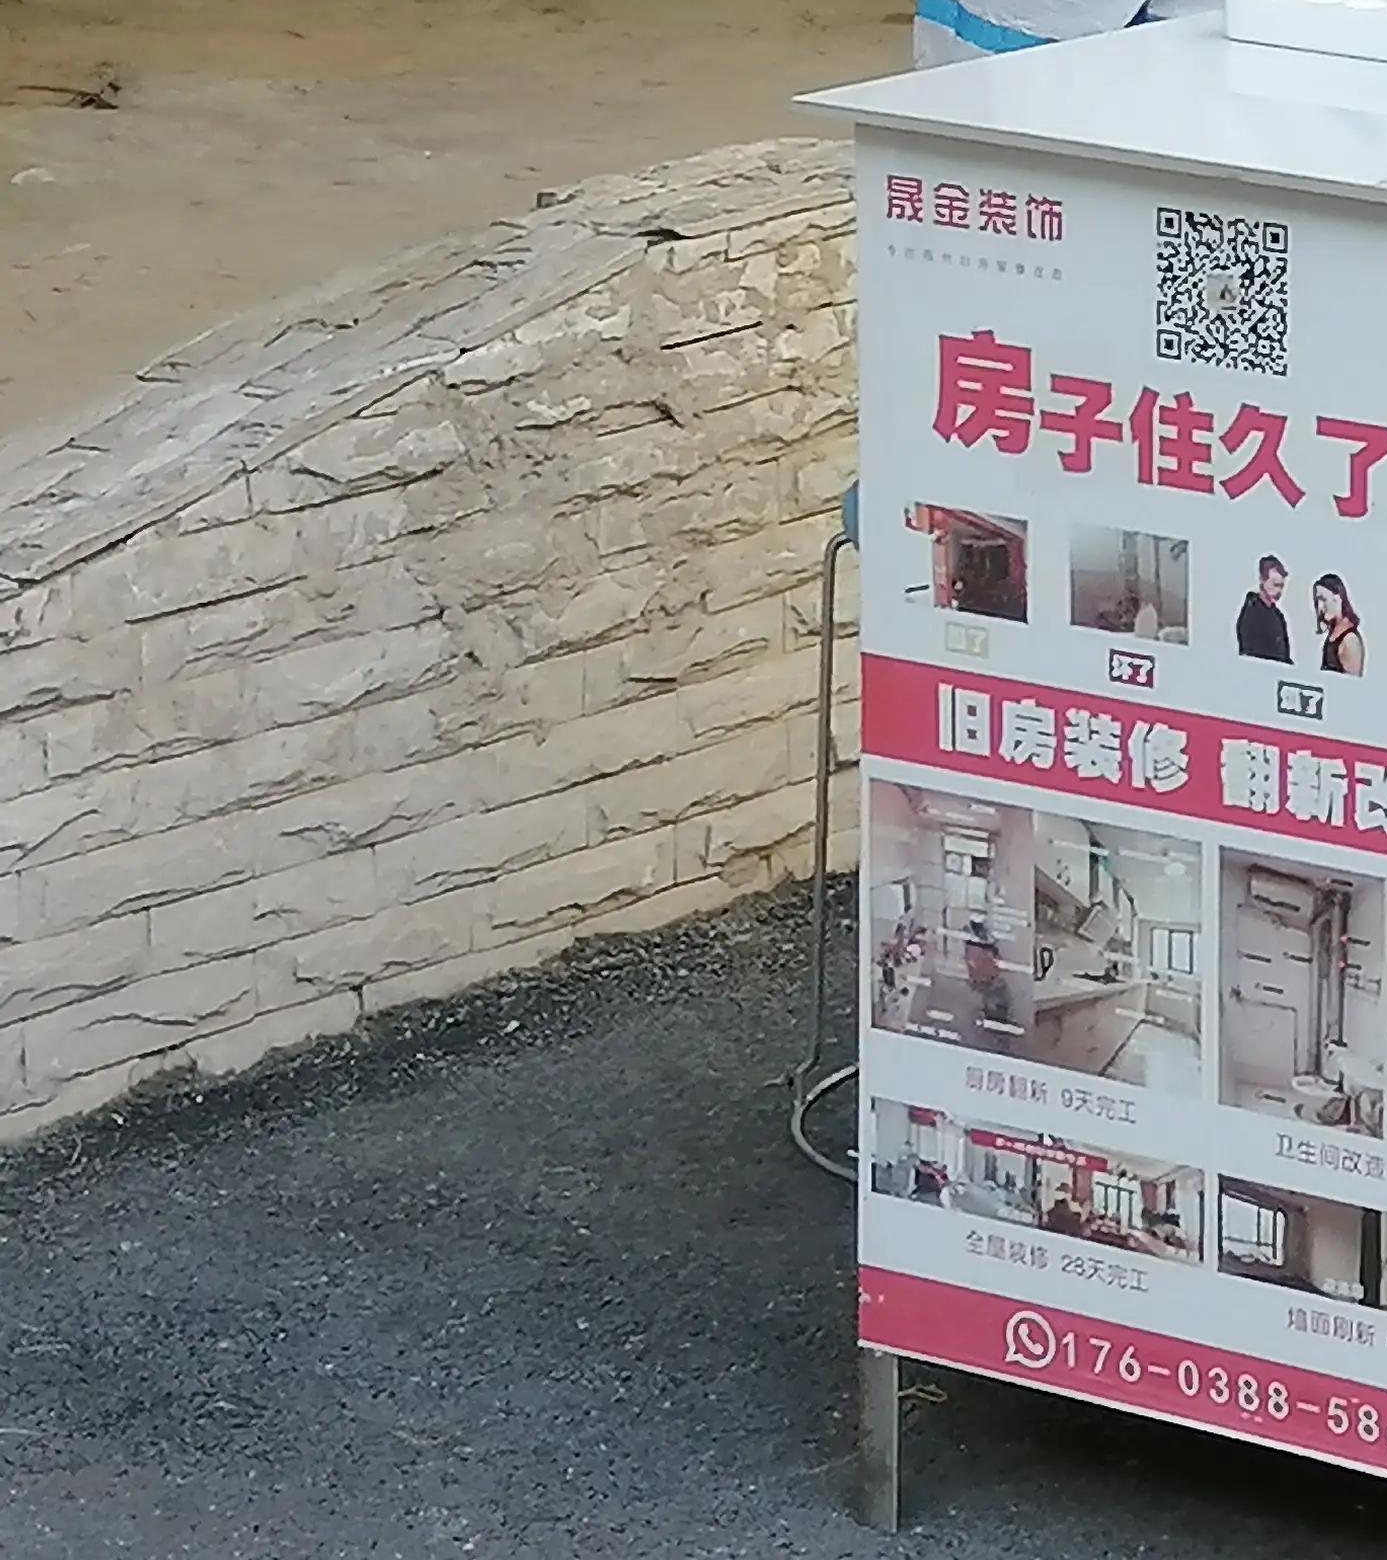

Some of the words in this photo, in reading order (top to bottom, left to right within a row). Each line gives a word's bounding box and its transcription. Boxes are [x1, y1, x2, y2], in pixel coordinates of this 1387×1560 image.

[886, 174, 1063, 242] 晟金装饰
[937, 683, 1190, 792] 旧房装修
